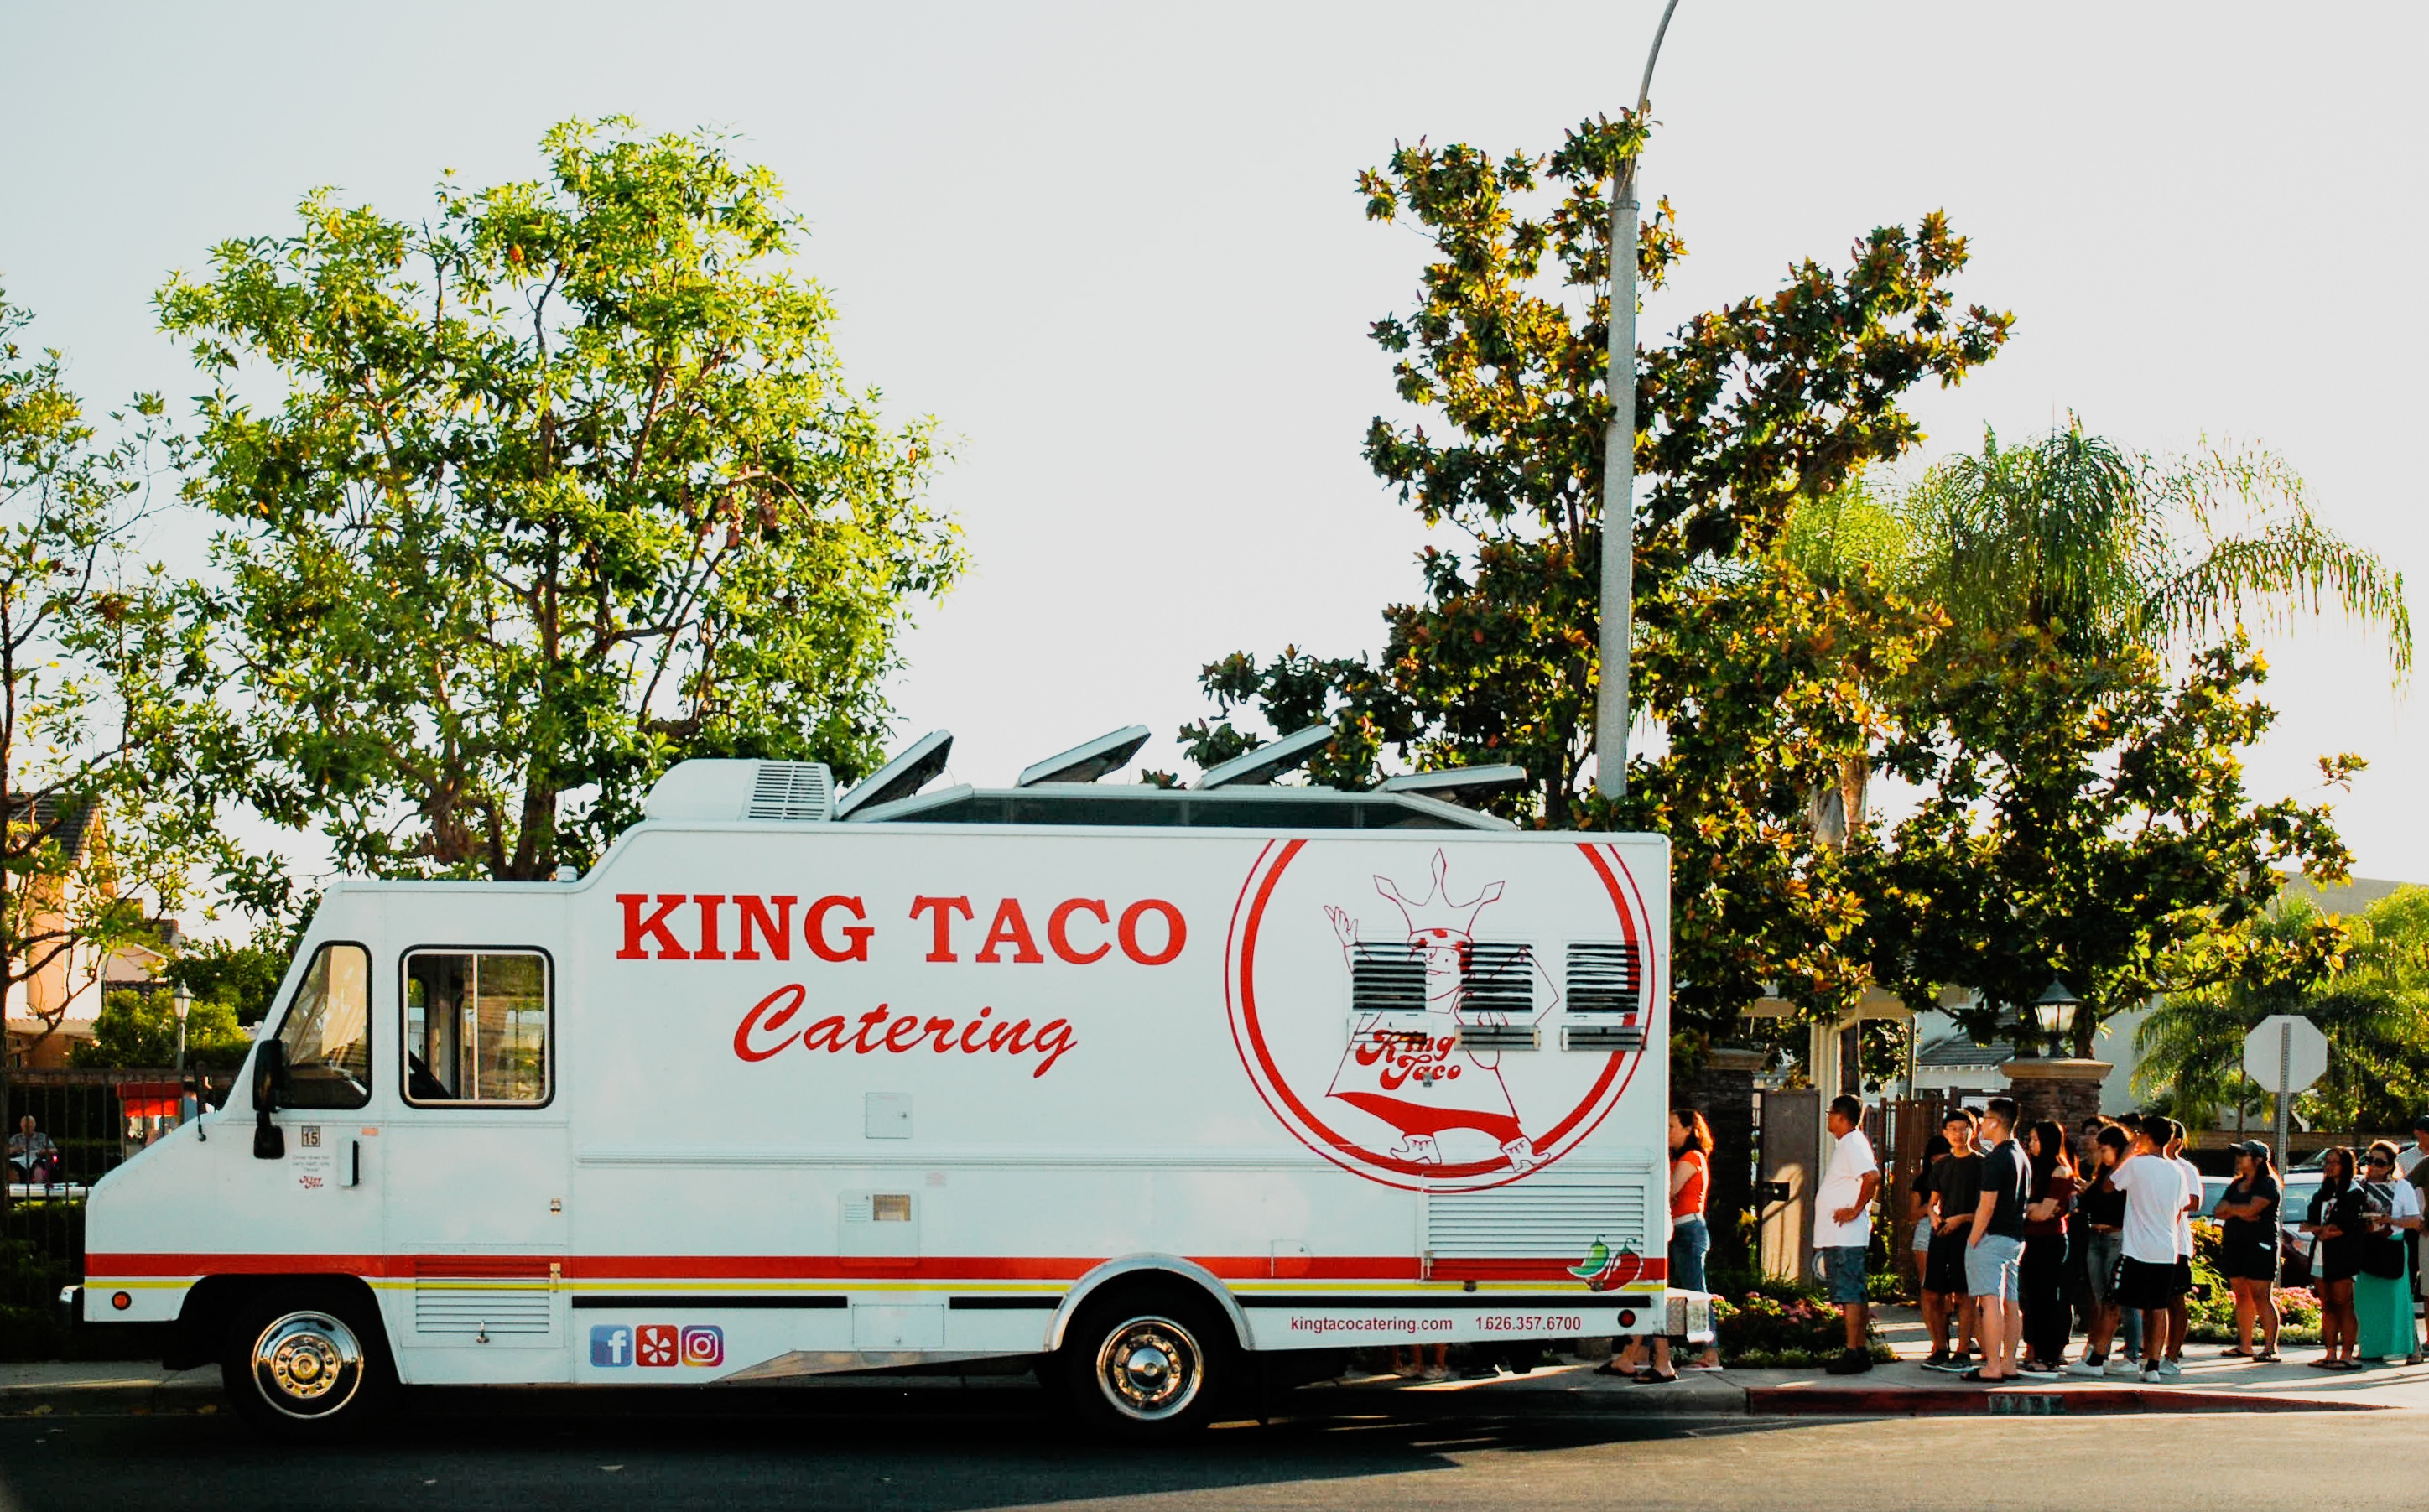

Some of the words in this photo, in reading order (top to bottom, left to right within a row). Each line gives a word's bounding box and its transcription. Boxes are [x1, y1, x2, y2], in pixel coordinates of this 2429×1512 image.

[616, 893, 875, 963] KING
[909, 895, 1188, 966] TACO
[733, 984, 1078, 1078] Catering
[1379, 1054, 1462, 1090] Taco
[304, 1132, 318, 1146] 15
[1291, 1316, 1453, 1334] kingtacocatering.com
